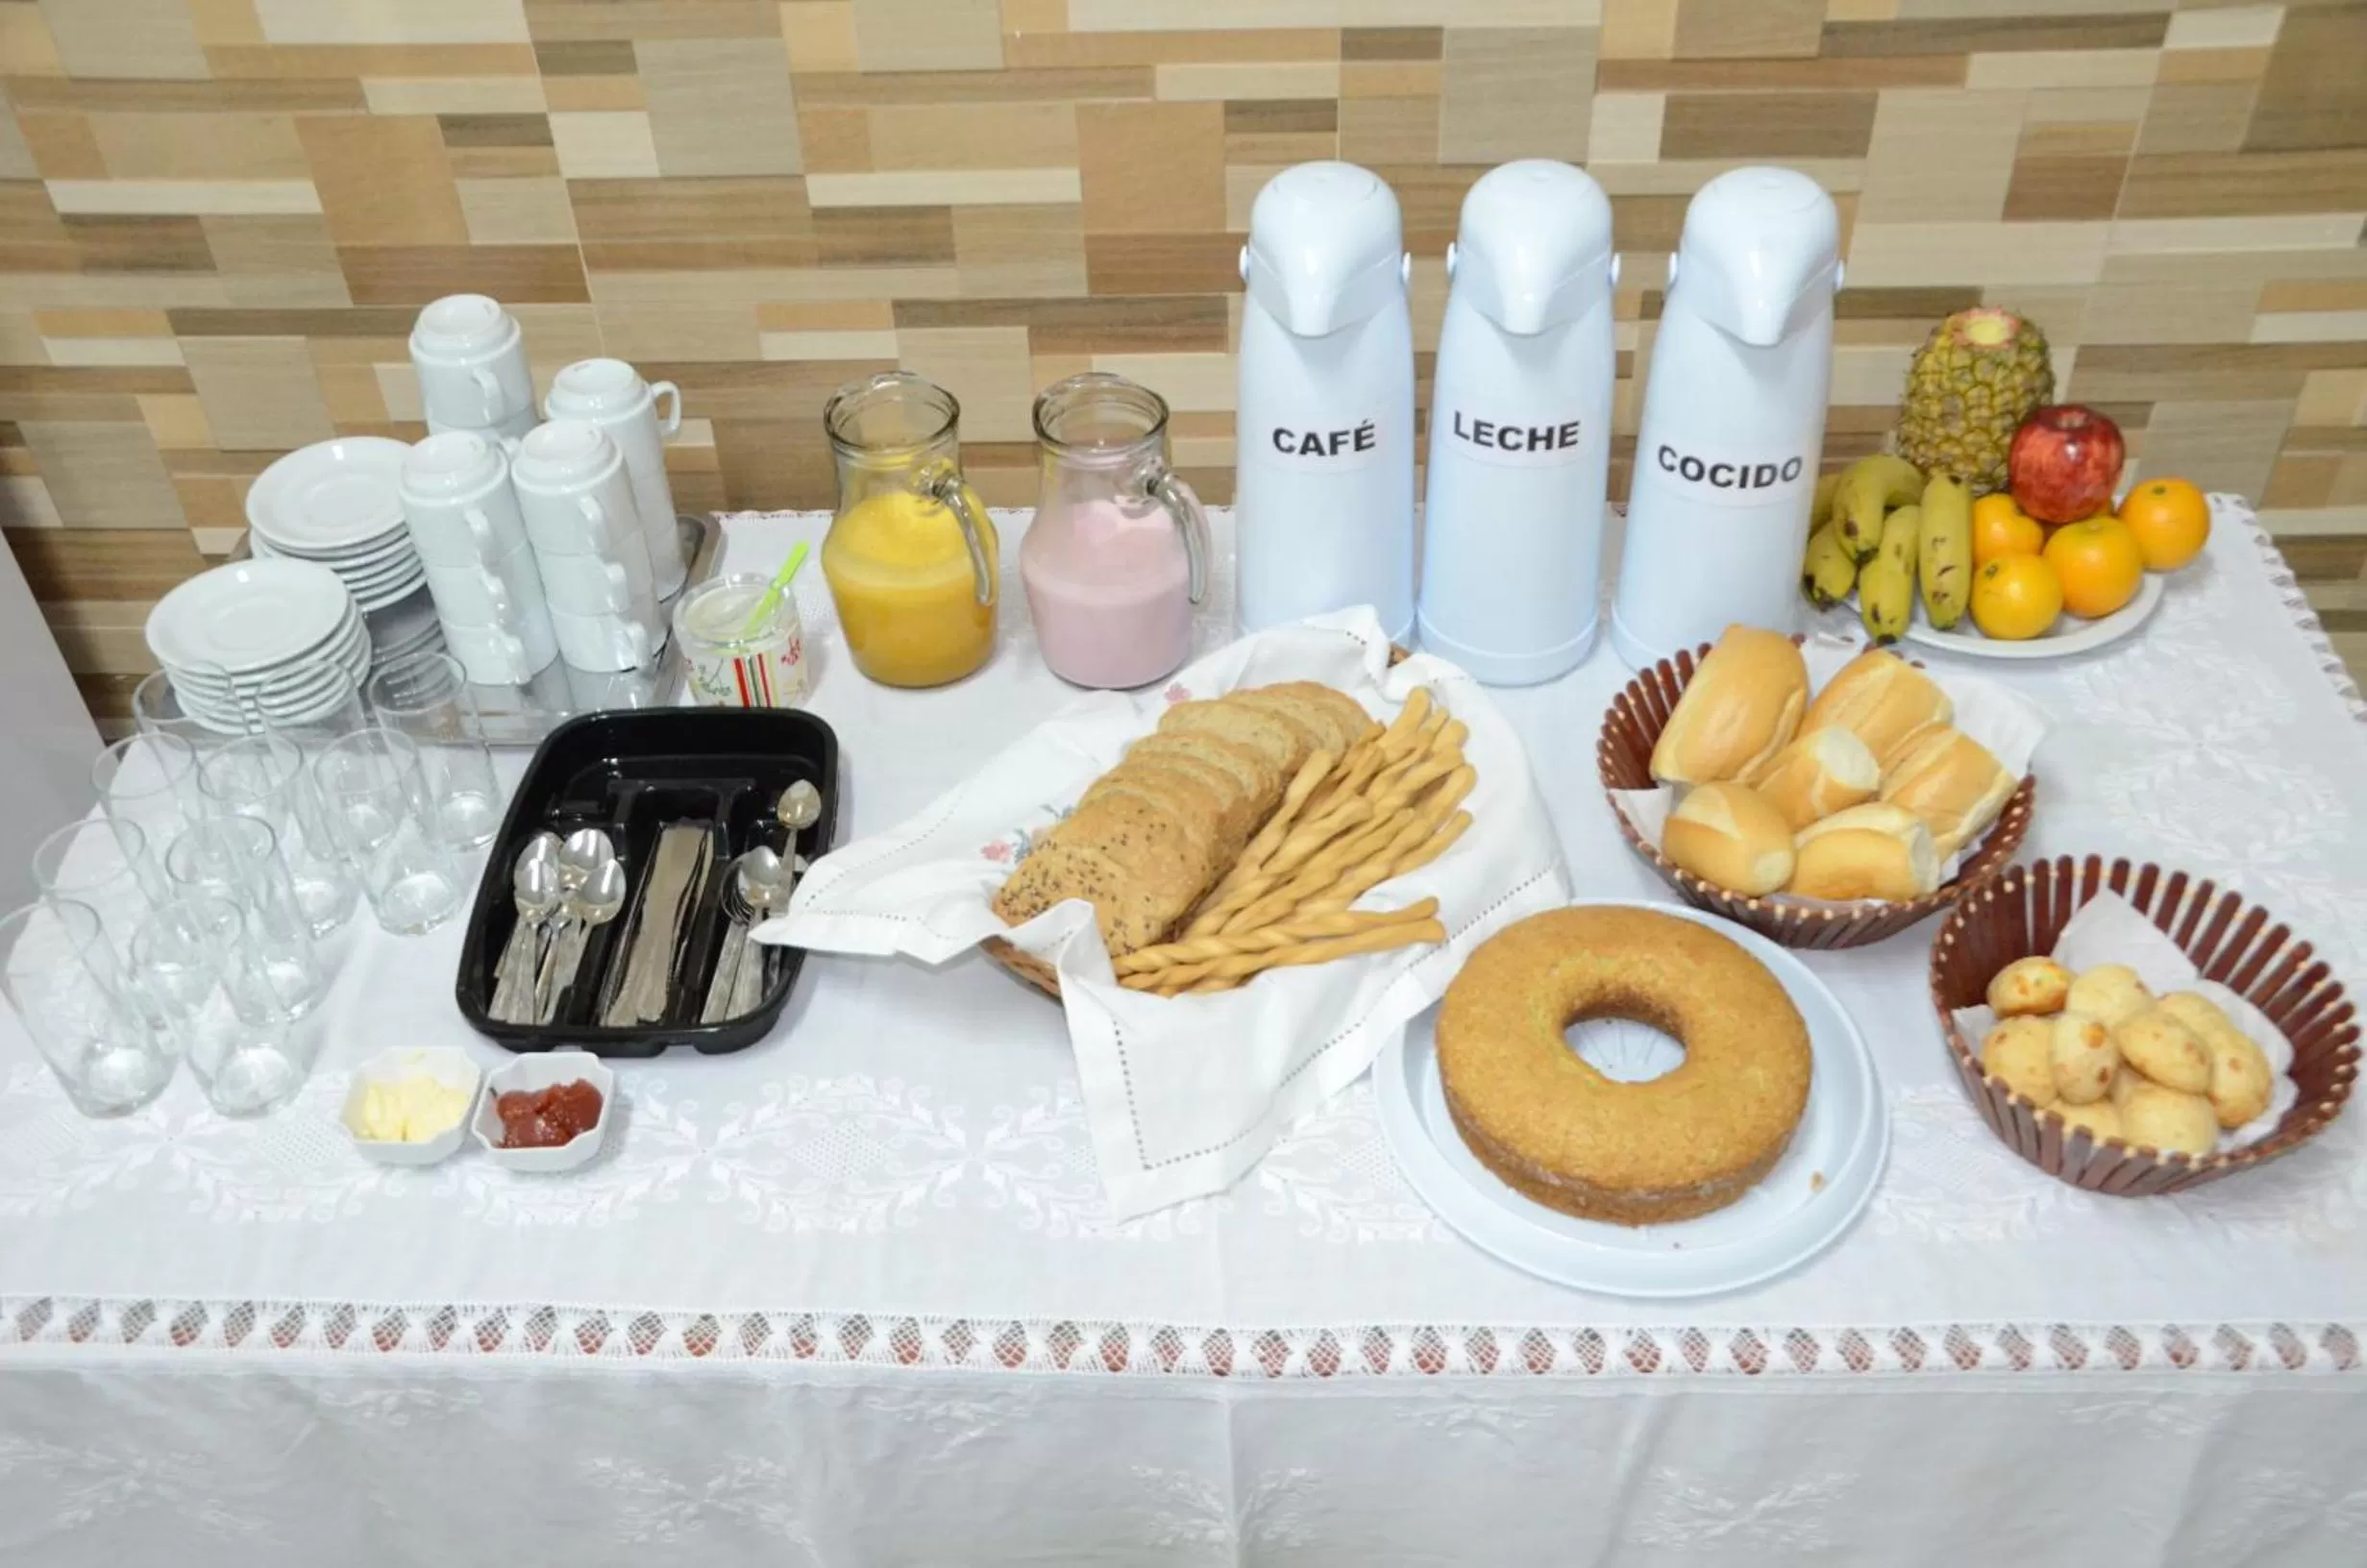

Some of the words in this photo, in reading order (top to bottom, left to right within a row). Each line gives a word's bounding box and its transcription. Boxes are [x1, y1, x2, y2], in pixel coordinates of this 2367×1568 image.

[1271, 418, 1377, 456] CAFÉ
[1453, 411, 1581, 452] LECHE
[1658, 444, 1803, 490] COCIDO
